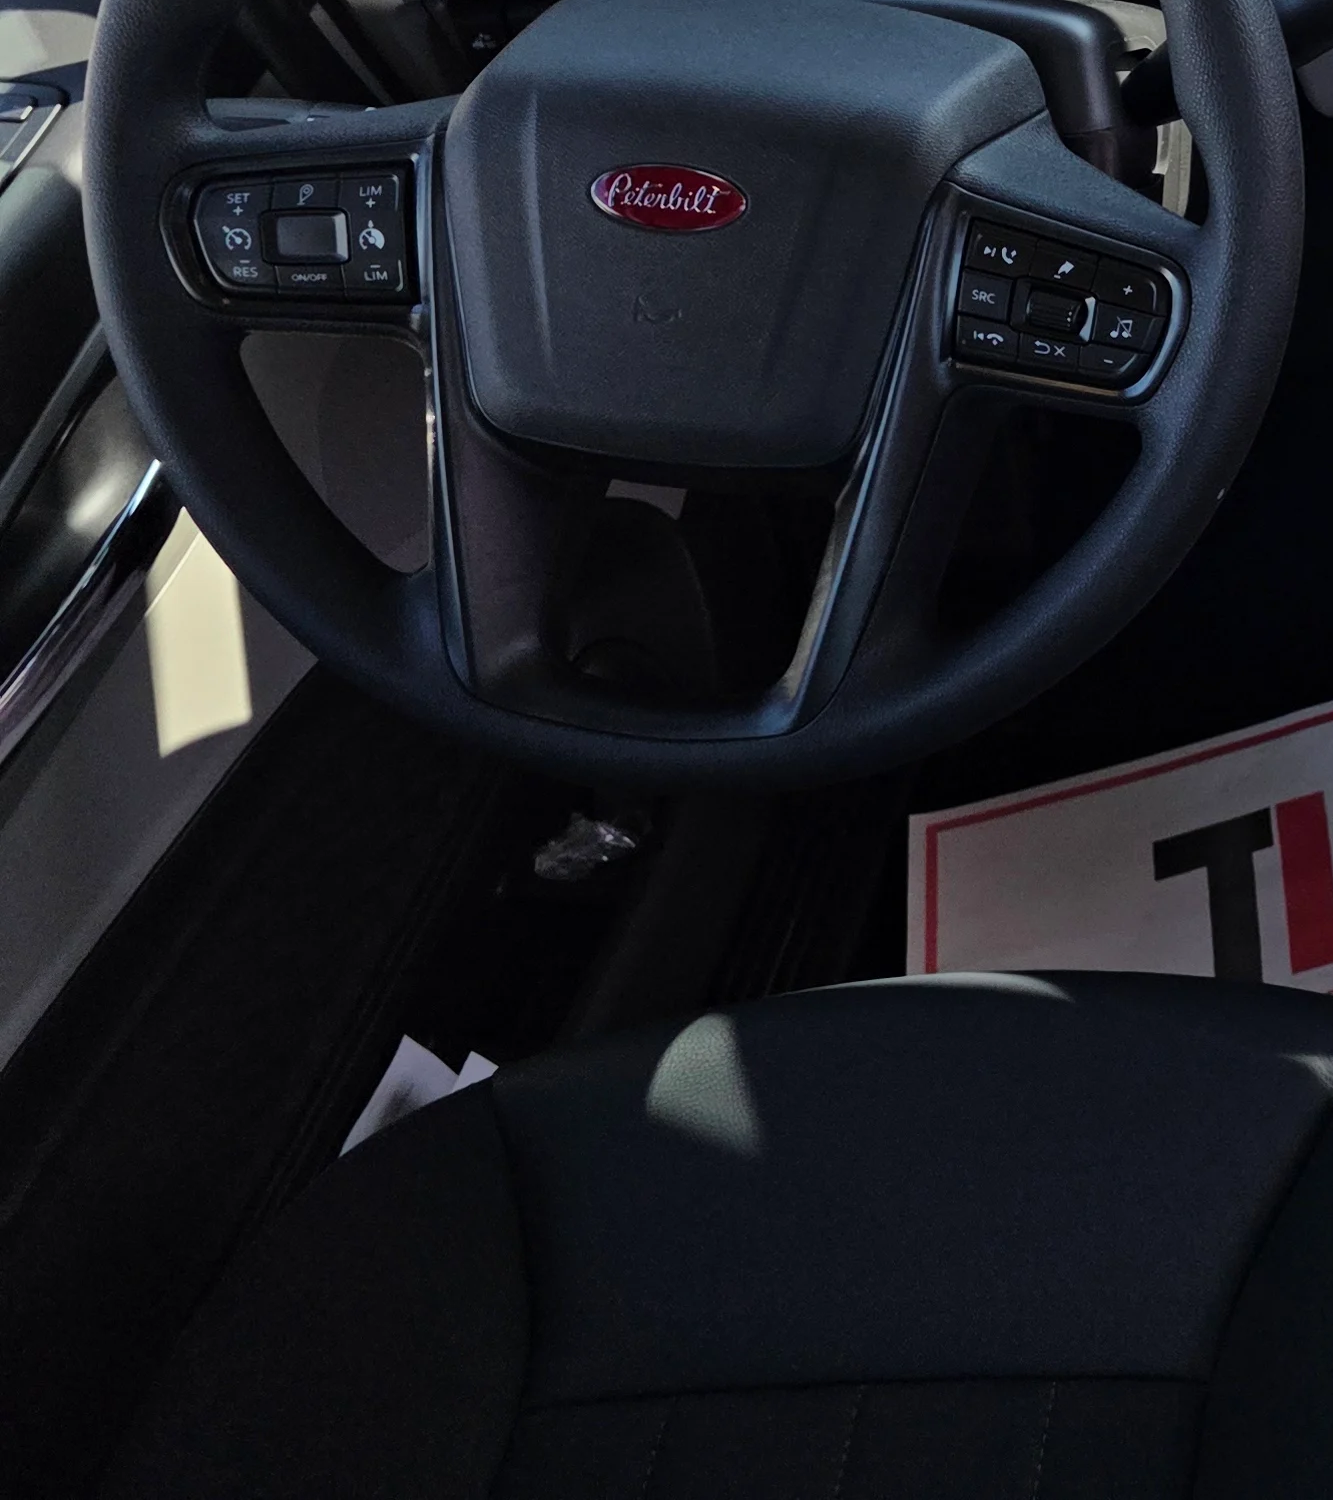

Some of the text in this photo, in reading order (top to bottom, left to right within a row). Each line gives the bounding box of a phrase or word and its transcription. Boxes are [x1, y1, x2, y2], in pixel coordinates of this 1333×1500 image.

[359, 185, 382, 197] LIM
[607, 172, 731, 214] Peterbilt
[226, 193, 250, 204] SET
[233, 266, 258, 278] RES
[291, 273, 327, 282] ON/OFF
[364, 271, 388, 281] LIM
[971, 289, 996, 305] SRC
